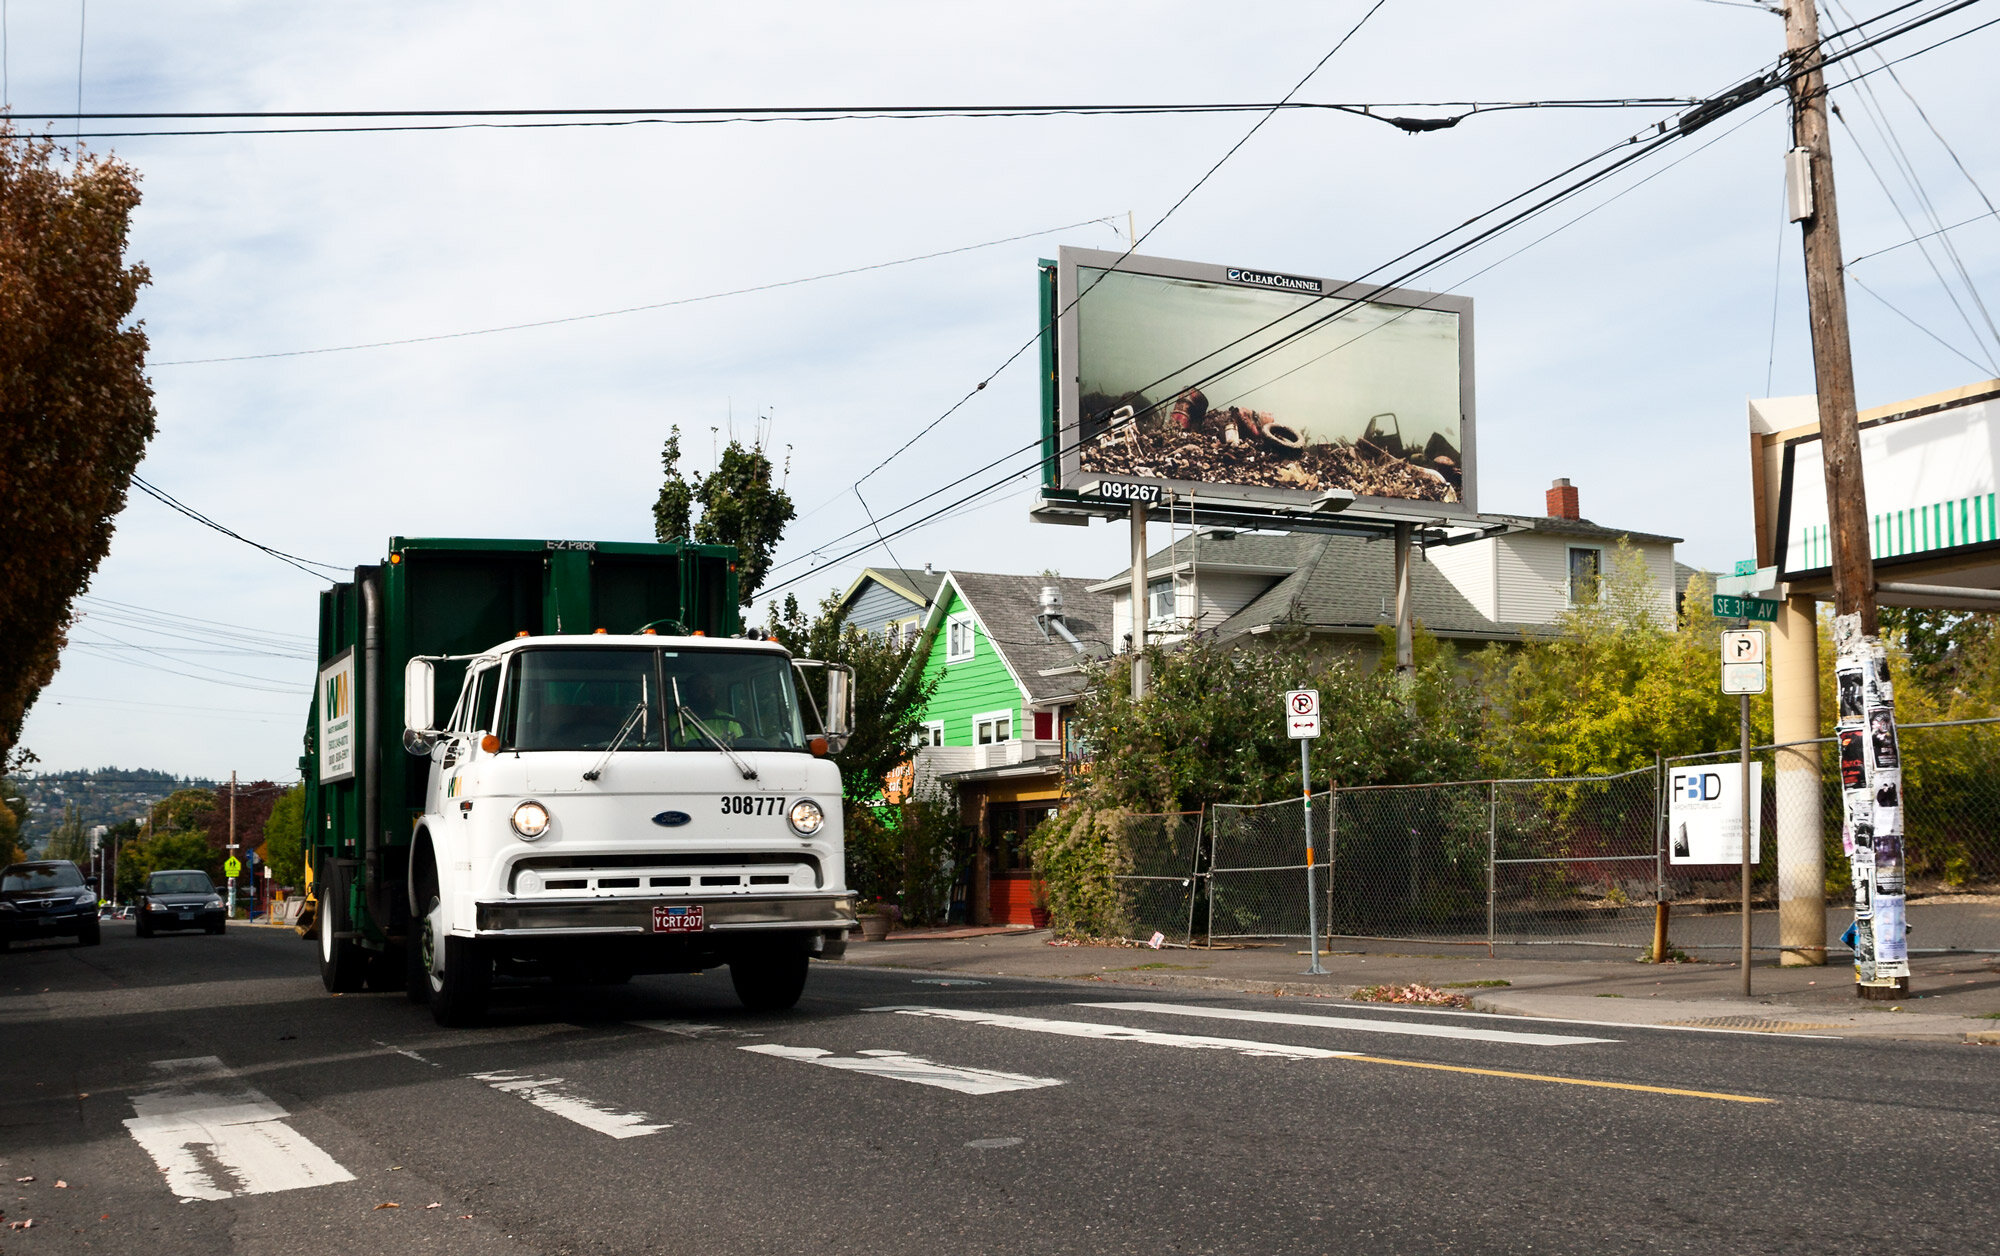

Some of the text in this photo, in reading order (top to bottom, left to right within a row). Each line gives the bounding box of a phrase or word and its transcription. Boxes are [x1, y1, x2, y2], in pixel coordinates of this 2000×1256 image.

[1102, 482, 1158, 501] 091267
[569, 540, 596, 551] Pack
[1717, 598, 1729, 614] SE
[1758, 603, 1773, 618] AV
[326, 670, 349, 721] WM
[447, 775, 462, 798] WM
[1674, 773, 1721, 802] FBD
[721, 796, 786, 815] 308777
